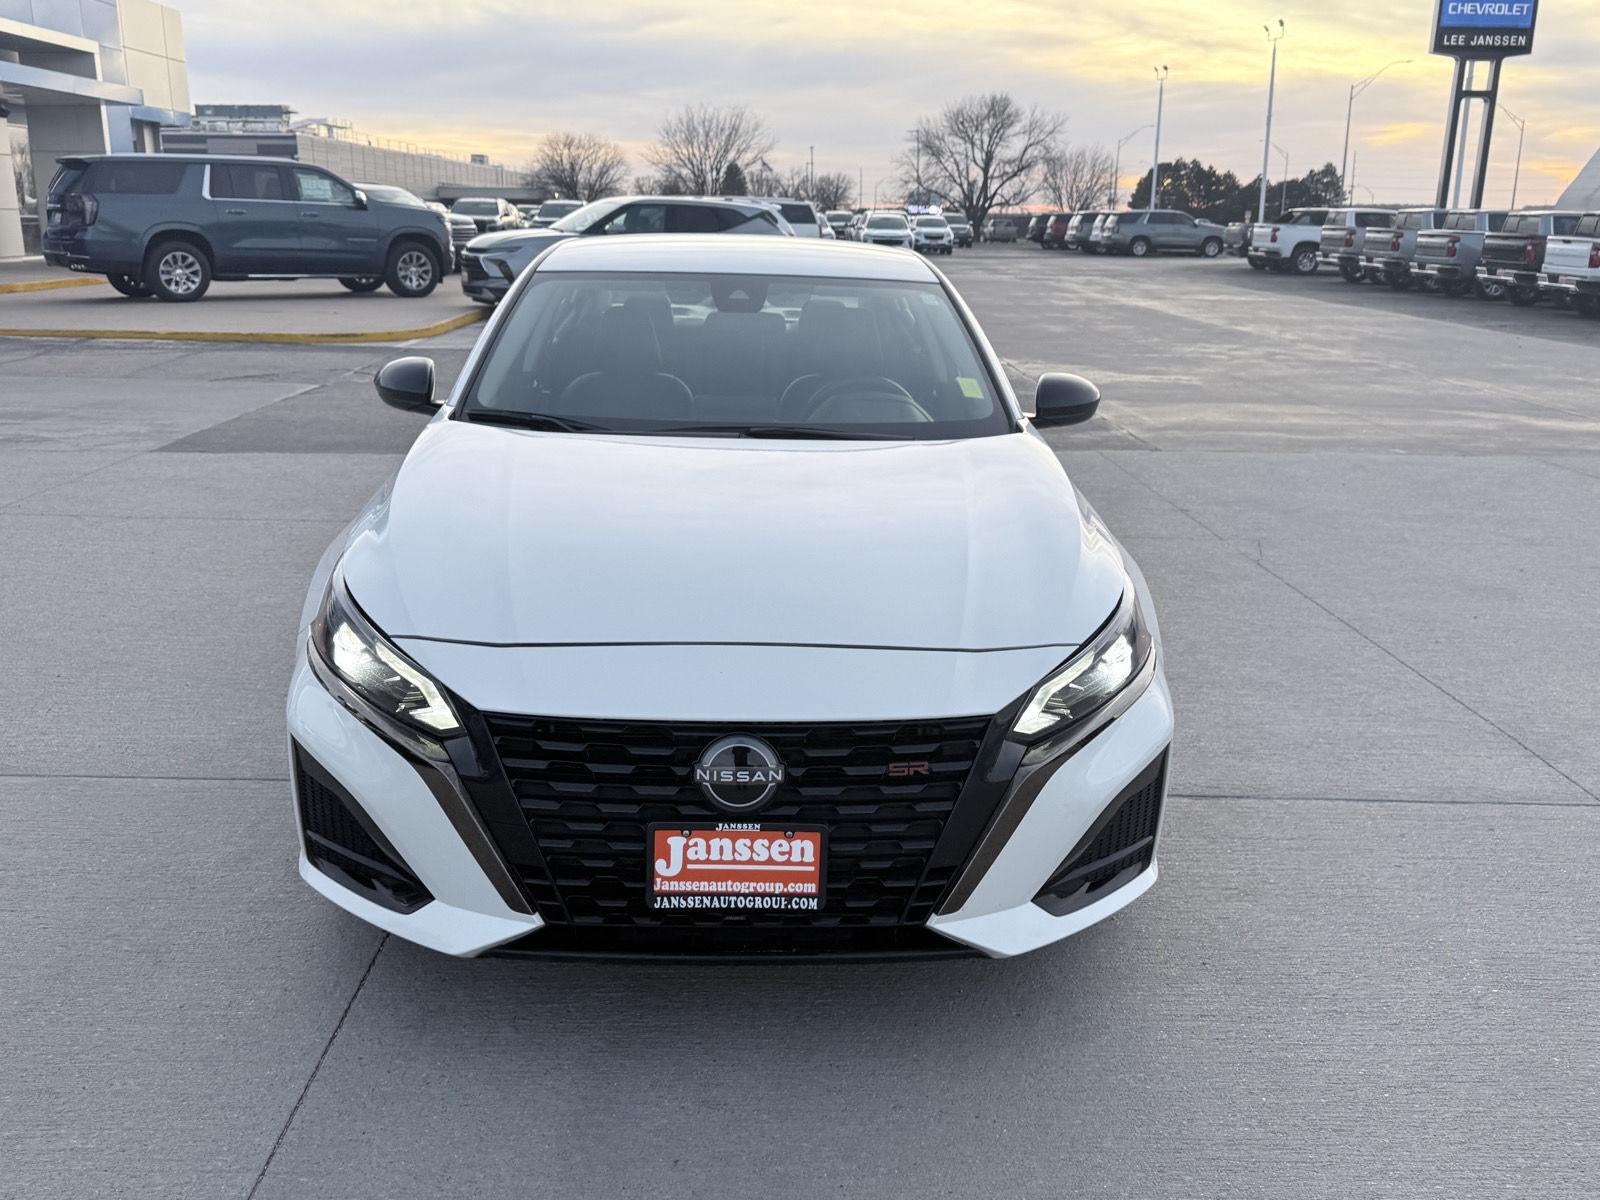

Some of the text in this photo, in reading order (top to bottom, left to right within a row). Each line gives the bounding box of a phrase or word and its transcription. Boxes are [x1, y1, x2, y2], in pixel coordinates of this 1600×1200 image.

[1448, 2, 1531, 15] CHEVROLET
[1444, 35, 1526, 46] LEE JANSSEN
[696, 768, 782, 782] NISSAN
[888, 761, 929, 776] SR
[715, 823, 761, 831] JANSSEN
[655, 836, 815, 877] Janssen
[654, 878, 816, 893] Janssenautogroup.com
